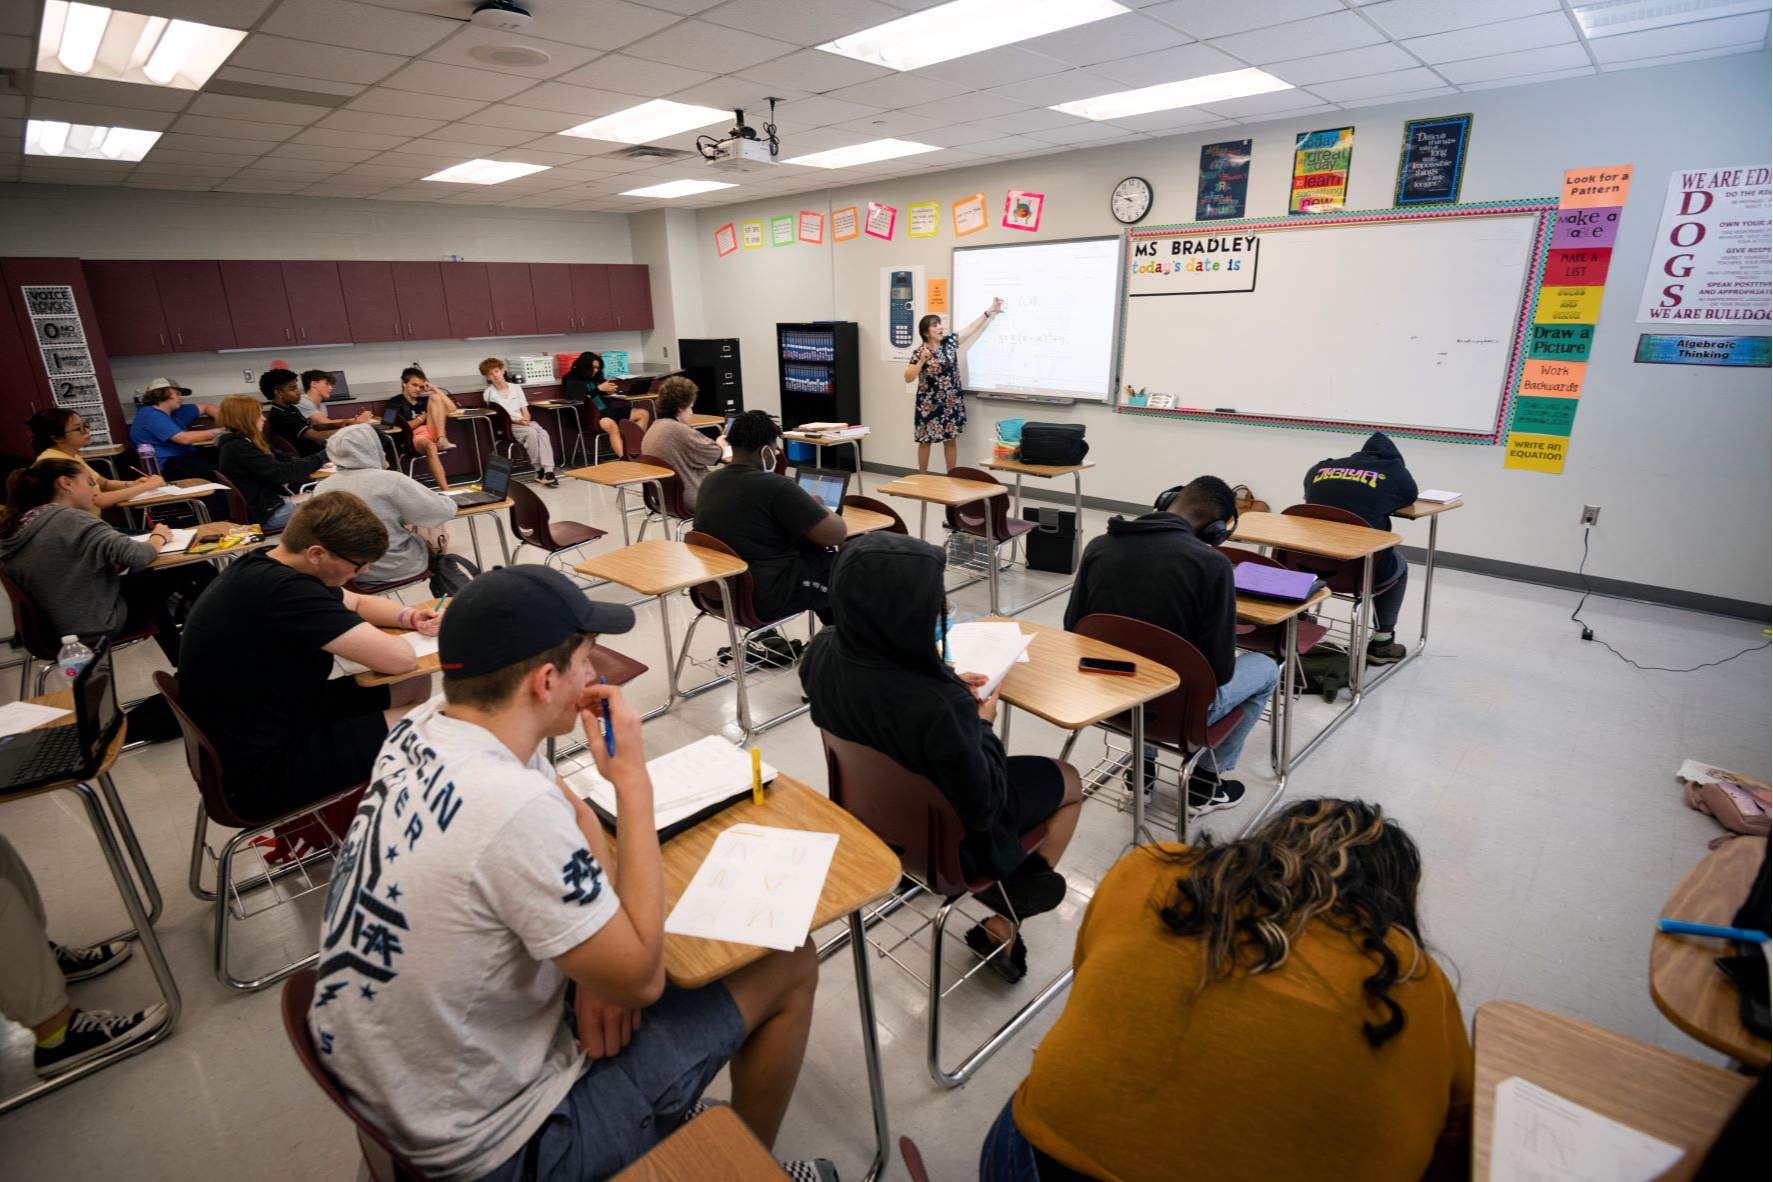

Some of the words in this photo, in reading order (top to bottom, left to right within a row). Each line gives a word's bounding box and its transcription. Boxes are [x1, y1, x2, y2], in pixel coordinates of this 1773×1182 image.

[1307, 146, 1345, 166] great
[1430, 148, 1448, 157] long
[1313, 159, 1336, 172] day
[1415, 168, 1438, 176] things
[1304, 174, 1340, 188] learn
[1566, 175, 1596, 184] Look
[1599, 173, 1618, 182] for
[1621, 173, 1629, 181] a
[1682, 172, 1707, 189] WE
[1708, 170, 1742, 189] ARE
[1571, 185, 1620, 196] Pattern
[1558, 210, 1600, 225] Make
[1607, 212, 1617, 222] a
[1135, 242, 1157, 257] MS
[1171, 236, 1256, 255] BRADLEY
[1561, 253, 1586, 263] MAKE
[1591, 252, 1597, 262] A
[1132, 260, 1181, 275] today's
[1186, 258, 1220, 273] date
[1227, 259, 1241, 271] is
[1566, 267, 1587, 276] LIST
[30, 291, 69, 300] VOICE
[1650, 309, 1671, 319] WE
[1673, 309, 1701, 319] ARE
[43, 322, 58, 339] 0
[1534, 326, 1575, 339] Draw
[1580, 328, 1590, 339] a
[1534, 341, 1586, 354] Picture
[1676, 340, 1736, 349] Algebraic
[1678, 350, 1730, 360] Thinking
[1540, 365, 1569, 376] Work
[60, 382, 75, 398] 2
[1524, 380, 1578, 392] Backwards
[1514, 441, 1545, 450] WRITE
[1547, 443, 1561, 451] AN
[1510, 450, 1562, 461] EQUATION
